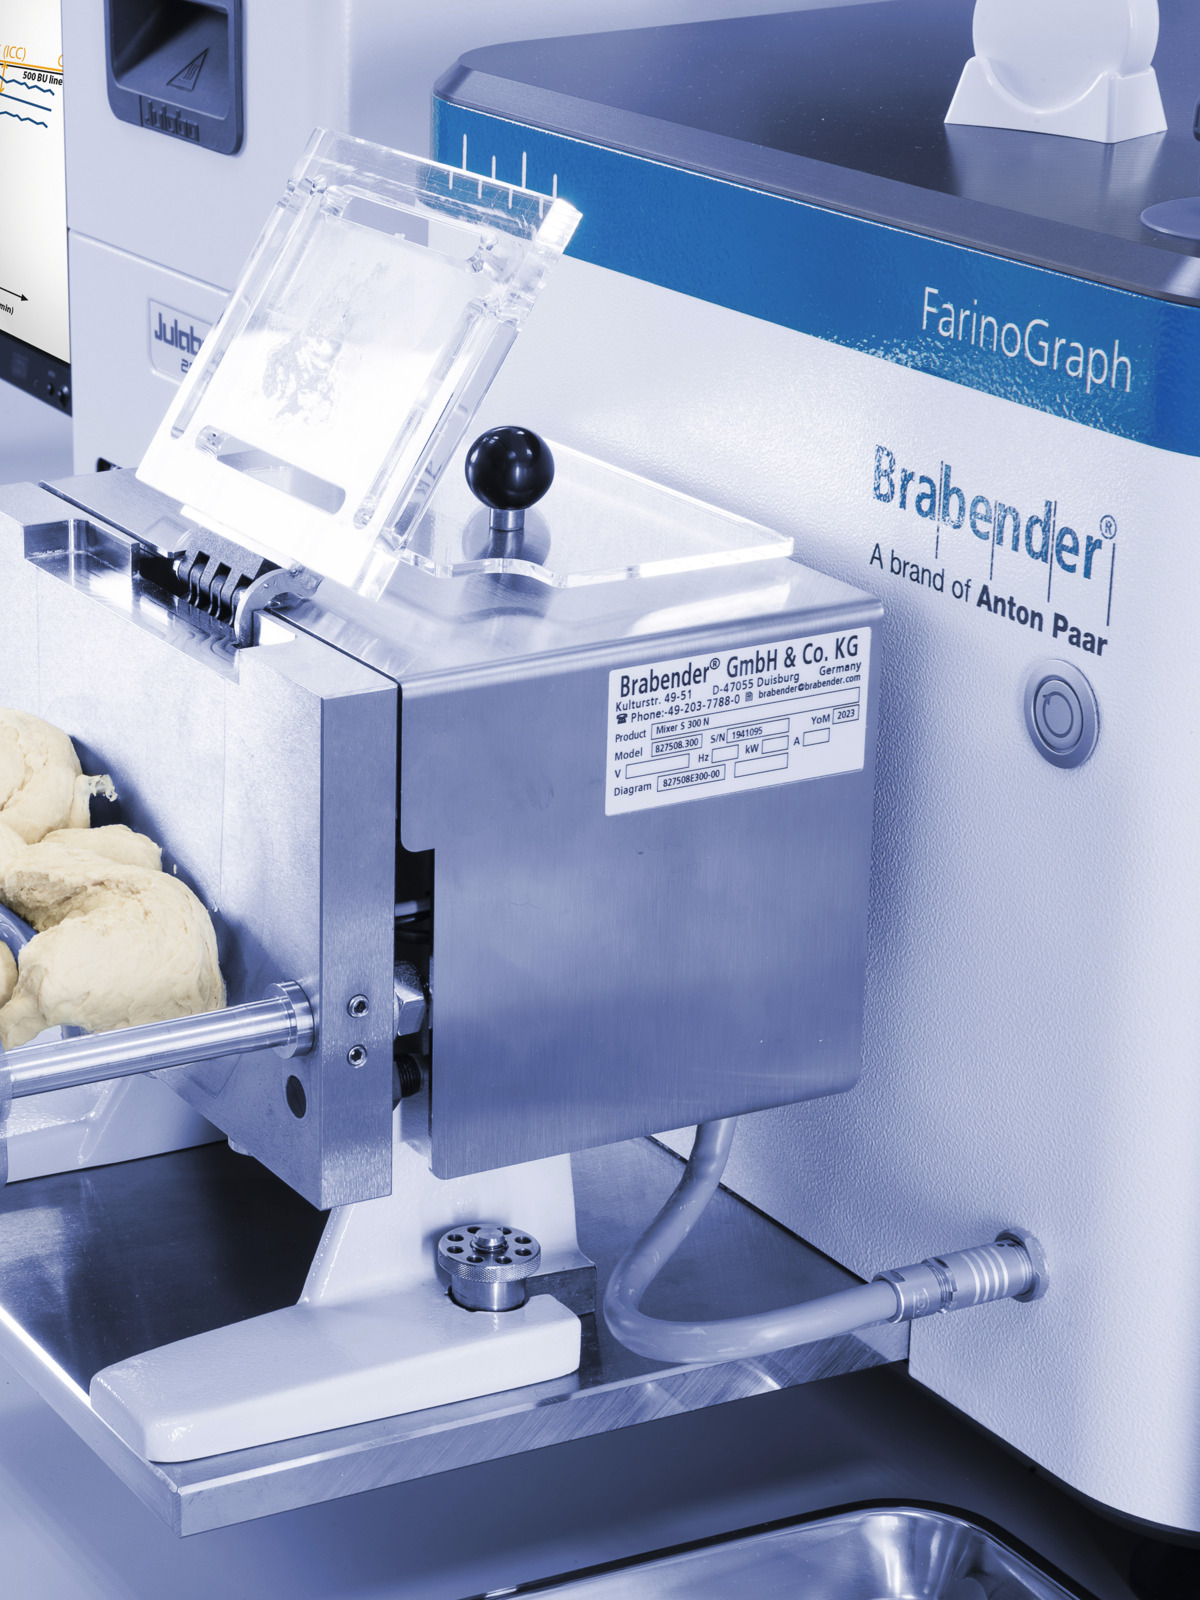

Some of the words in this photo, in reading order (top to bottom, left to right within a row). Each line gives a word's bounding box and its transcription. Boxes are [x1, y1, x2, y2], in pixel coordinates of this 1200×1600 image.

[3, 44, 27, 62] (ICC)
[22, 71, 36, 81] 500
[37, 72, 49, 83] BU
[49, 74, 63, 86] line
[154, 312, 205, 357] Julab
[921, 285, 1132, 394] FarinoGraph
[869, 542, 884, 569] A
[890, 548, 945, 593] brand
[951, 577, 972, 602] of
[976, 583, 1043, 632] Anton
[1051, 612, 1108, 656] Paar
[726, 649, 778, 678] GmbH
[783, 646, 796, 668] &
[802, 642, 828, 665] Co.
[835, 634, 859, 660] KG
[615, 696, 661, 712] Kulturstr.
[664, 689, 692, 703] 49-51
[712, 678, 754, 695] D-47055
[757, 672, 800, 688] Duisburg
[819, 661, 862, 676] Germany
[758, 674, 861, 699] brabender@brabender.com
[614, 747, 643, 761] Model
[655, 737, 699, 754] 827508.300
[710, 732, 726, 744] S/N
[732, 726, 763, 740] 1941095
[811, 713, 831, 725] YoM
[837, 708, 855, 720] 2023
[615, 729, 647, 743] Product
[656, 723, 678, 735] Mixer
[680, 722, 685, 730] S
[687, 718, 702, 729] 300
[703, 717, 710, 726] N
[614, 769, 622, 778] V
[698, 753, 709, 763] Hz
[745, 743, 760, 754] kW
[793, 736, 800, 746] A
[613, 782, 652, 797] Diagram
[662, 769, 721, 788] 827508E300-00
